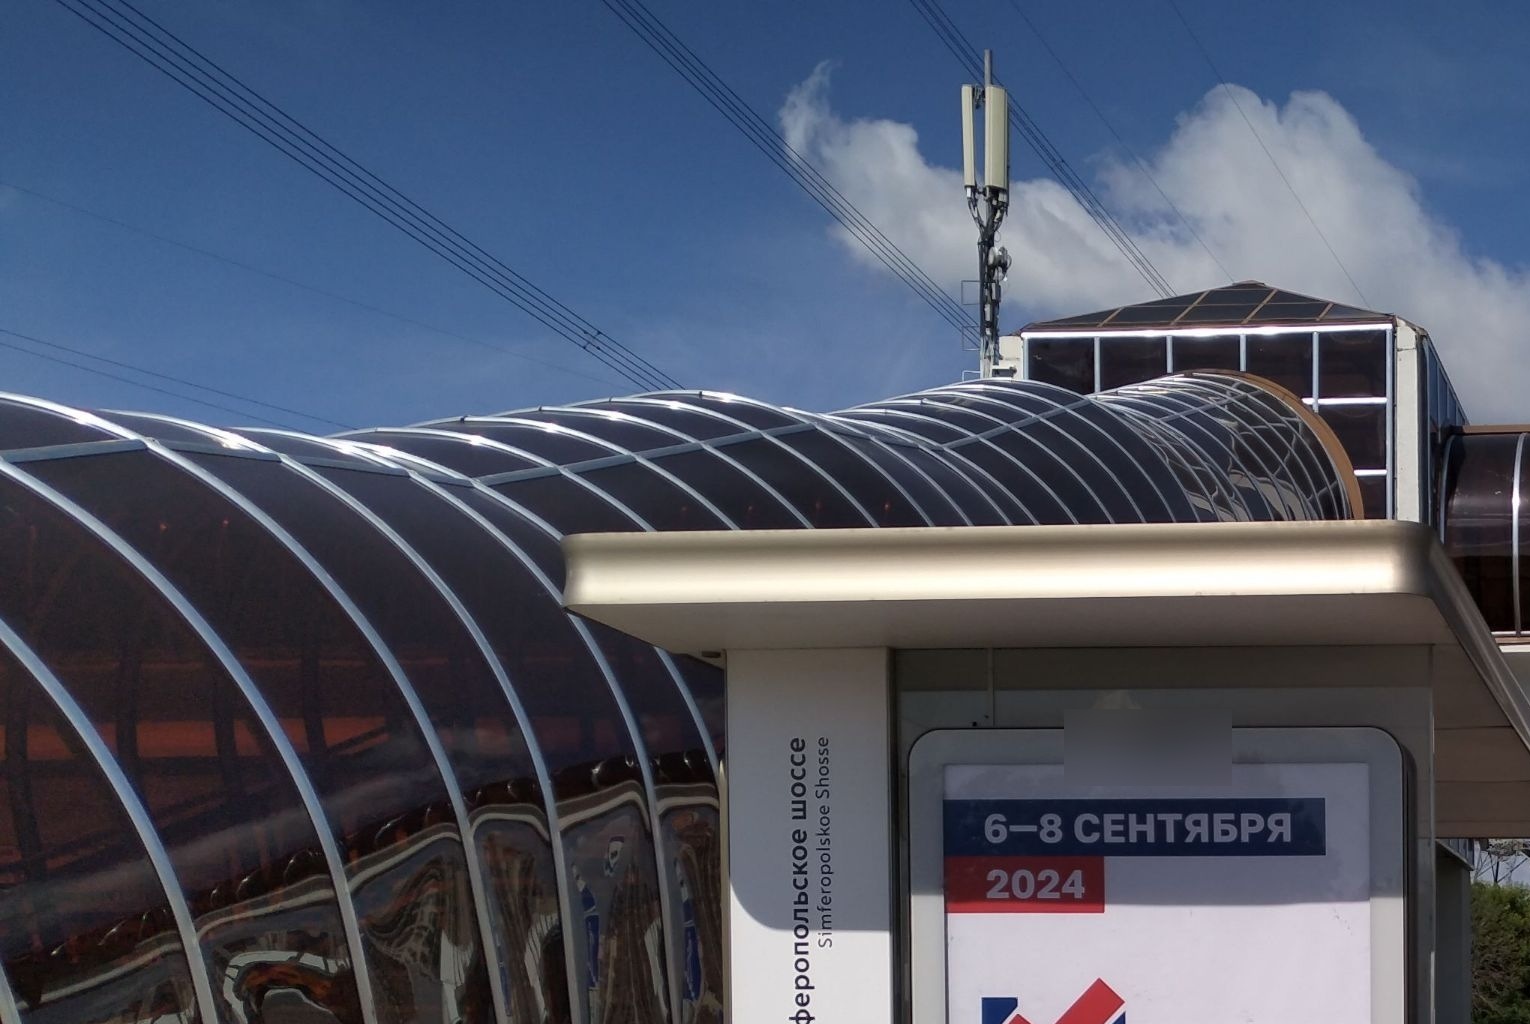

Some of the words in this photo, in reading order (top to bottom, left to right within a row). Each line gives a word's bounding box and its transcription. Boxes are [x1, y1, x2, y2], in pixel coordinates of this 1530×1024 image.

[789, 736, 807, 820] шоссе
[814, 736, 831, 799] Shosse
[1074, 812, 1292, 844] СЕНТЯБРЯ
[815, 805, 834, 948] Simferopolskoe
[986, 869, 1085, 899] 2024
